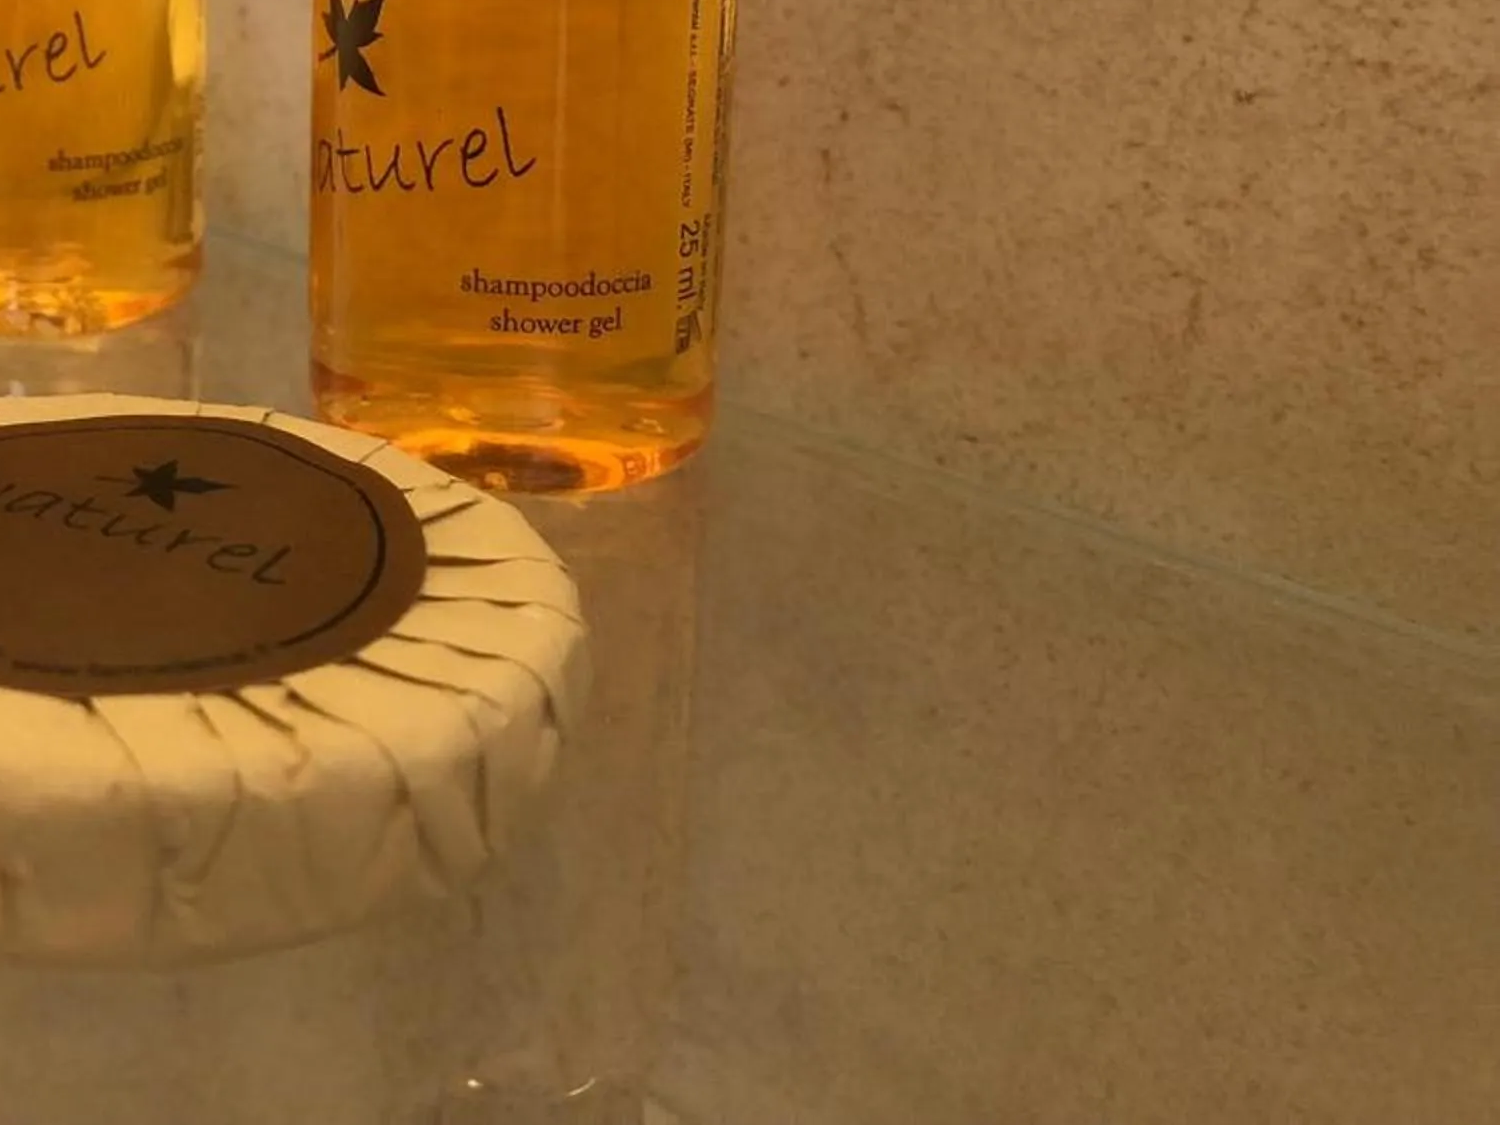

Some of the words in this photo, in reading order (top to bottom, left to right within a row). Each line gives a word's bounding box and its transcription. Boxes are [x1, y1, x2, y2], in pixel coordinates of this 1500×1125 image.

[314, 106, 537, 194] aturel
[678, 219, 700, 259] 25
[460, 267, 653, 303] shampoodoccia
[489, 306, 583, 335] shower
[587, 306, 624, 339] gel
